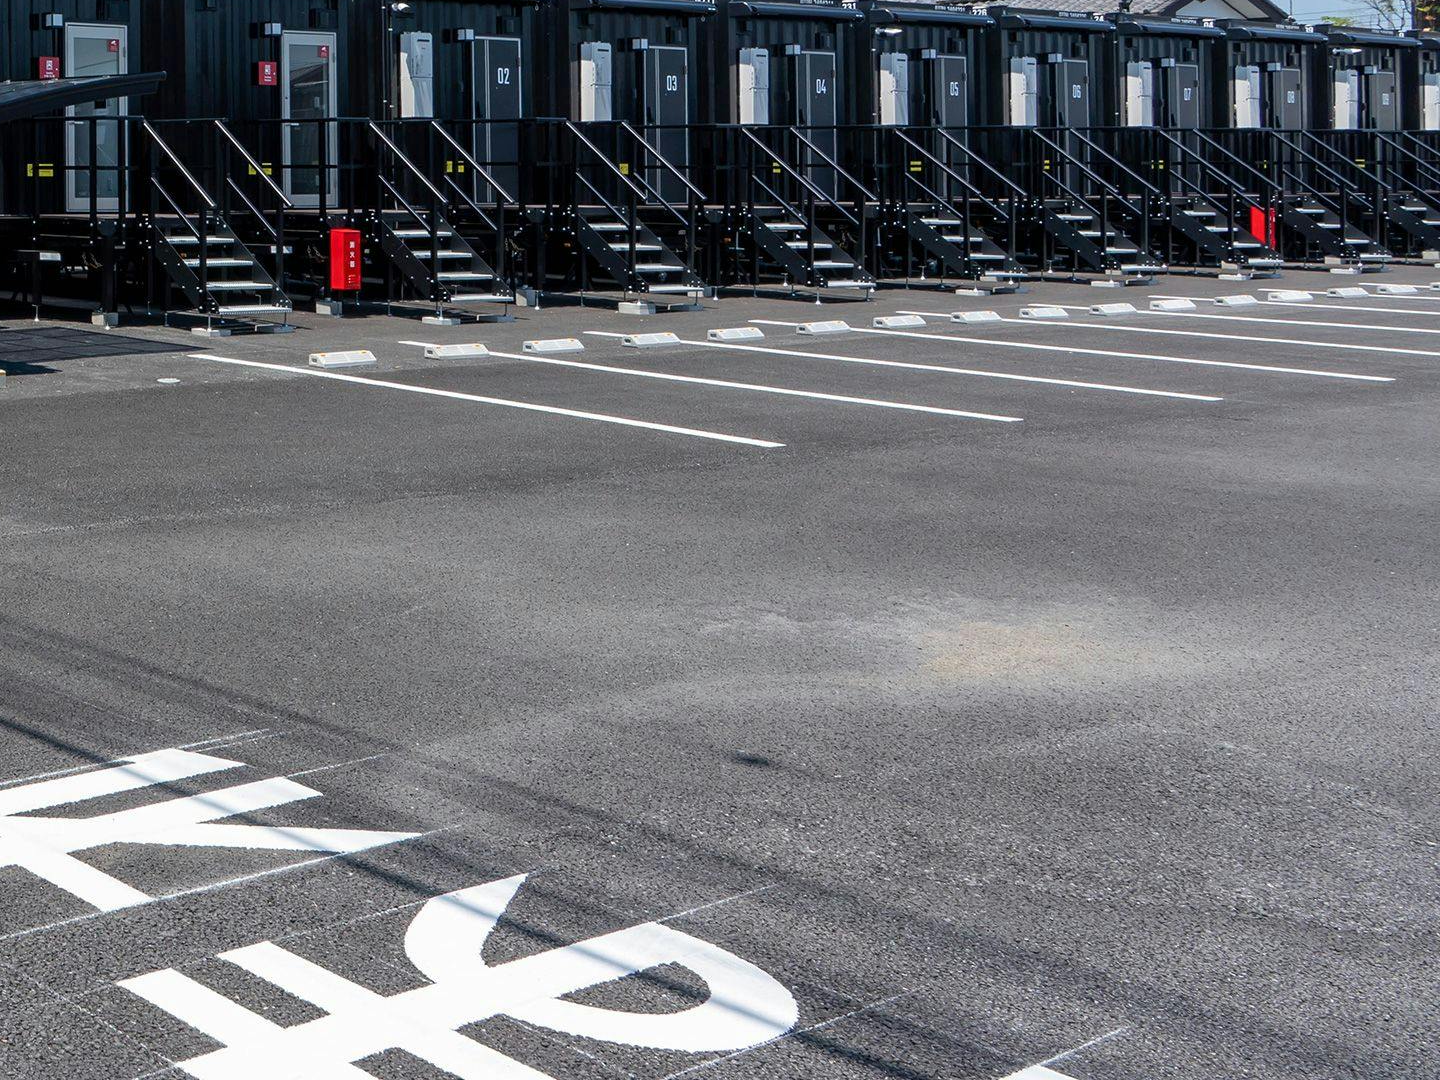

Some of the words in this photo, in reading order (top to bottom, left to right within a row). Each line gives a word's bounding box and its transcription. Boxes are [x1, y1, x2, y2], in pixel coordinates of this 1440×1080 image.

[497, 67, 510, 84] 02
[666, 75, 677, 91] 03
[816, 78, 826, 94] 04
[949, 81, 959, 96] 05
[1072, 84, 1081, 98] 06
